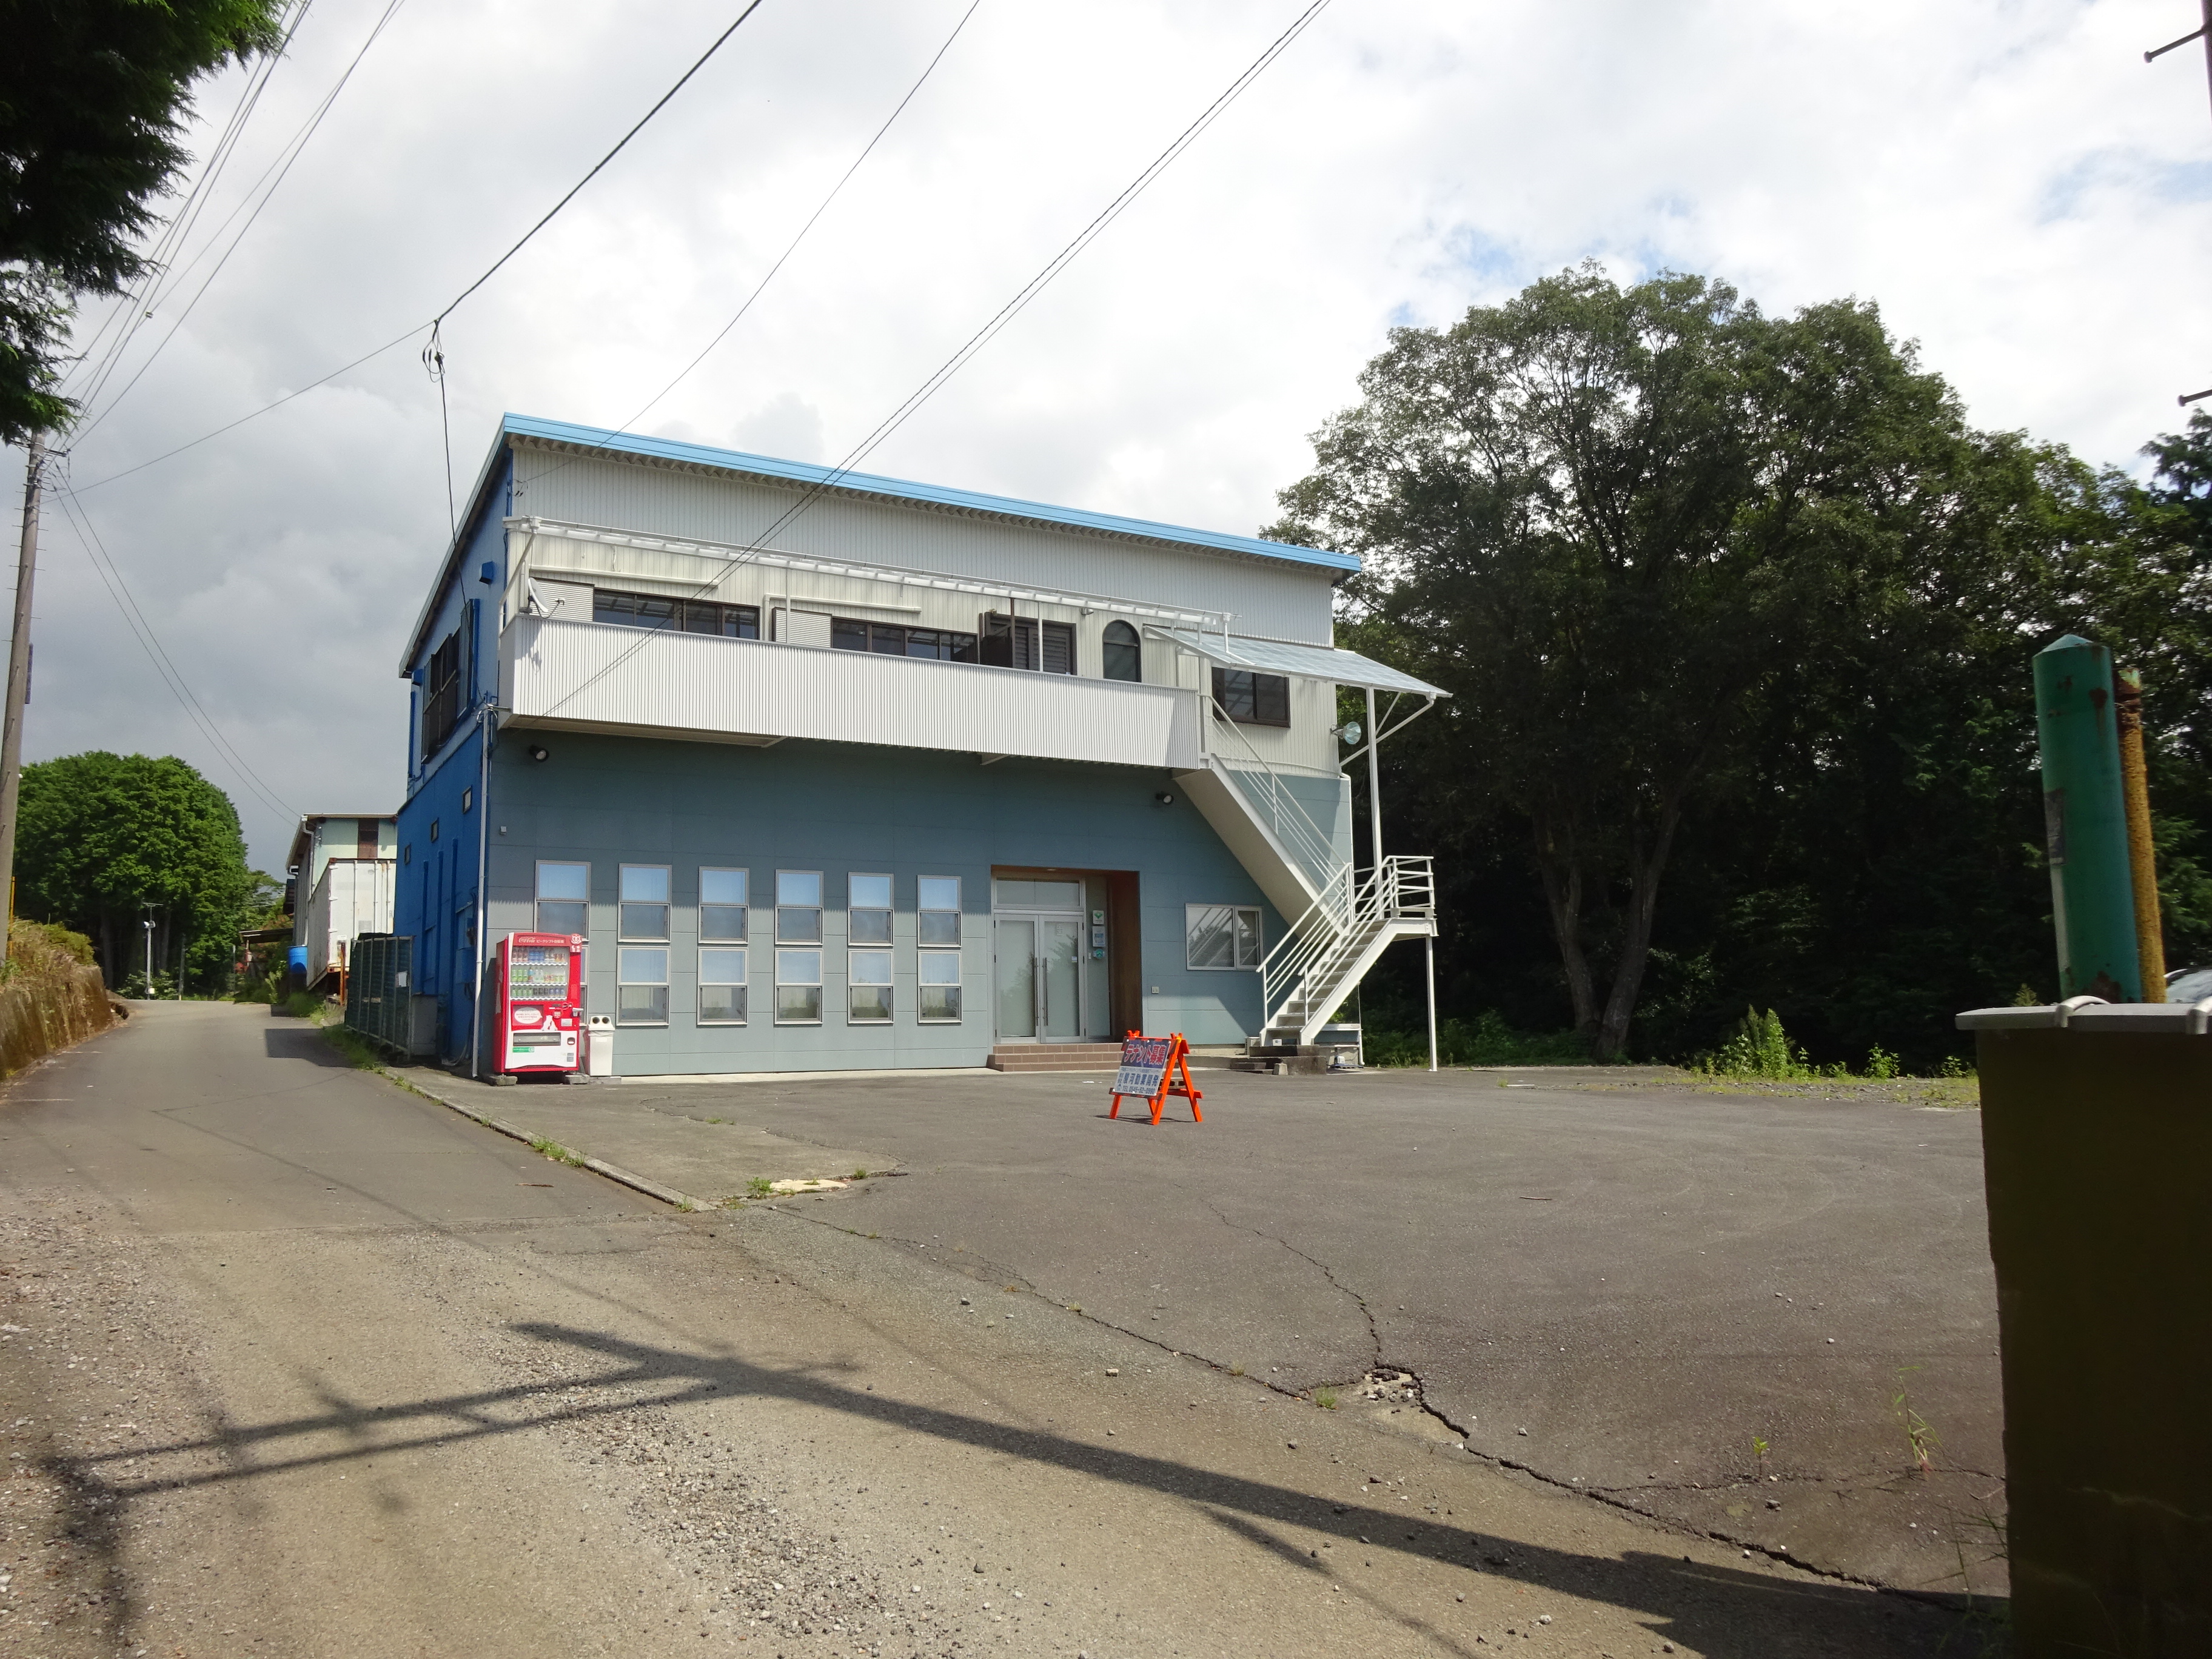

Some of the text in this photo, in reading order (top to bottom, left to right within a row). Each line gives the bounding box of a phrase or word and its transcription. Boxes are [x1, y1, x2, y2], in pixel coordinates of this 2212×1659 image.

[1124, 1044, 1167, 1065] テナント募集
